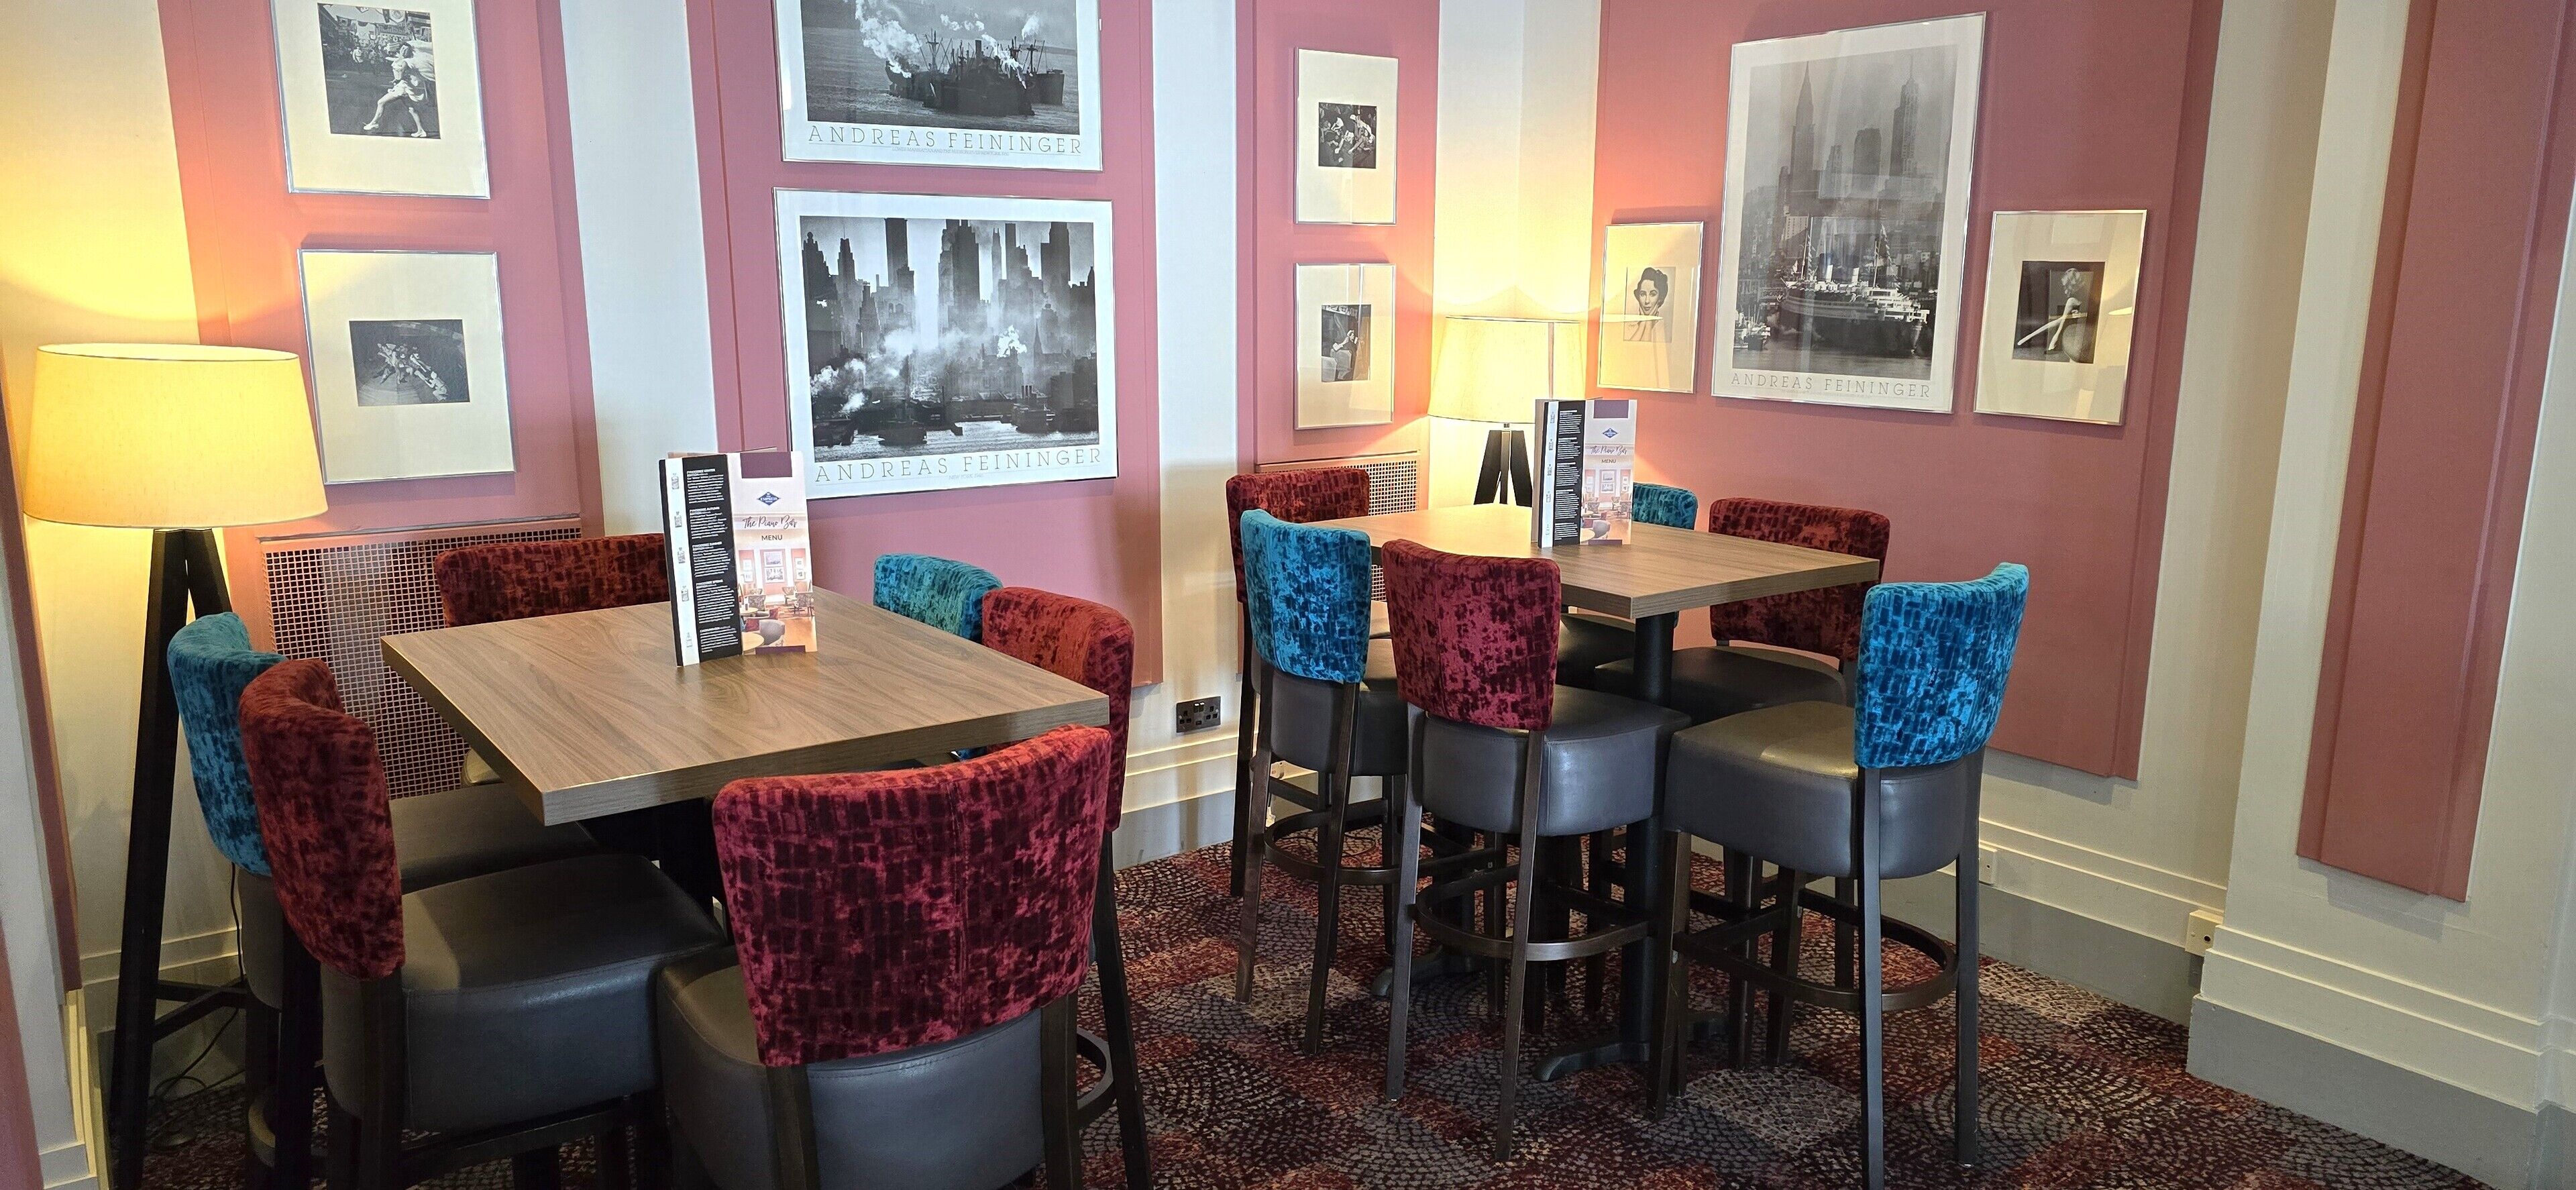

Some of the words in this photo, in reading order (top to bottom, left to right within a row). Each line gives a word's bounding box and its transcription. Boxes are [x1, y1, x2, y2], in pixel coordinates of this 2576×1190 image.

[808, 125, 936, 148] ANDREAS
[948, 132, 1081, 154] FEININGER
[1731, 372, 1813, 390] ANDREAS
[1824, 378, 1931, 398] FEININGER
[815, 457, 948, 482] ANDREAS
[963, 448, 1101, 472] FEININGER
[742, 516, 757, 529] The
[758, 516, 779, 528] Piano
[781, 515, 798, 530] Bar
